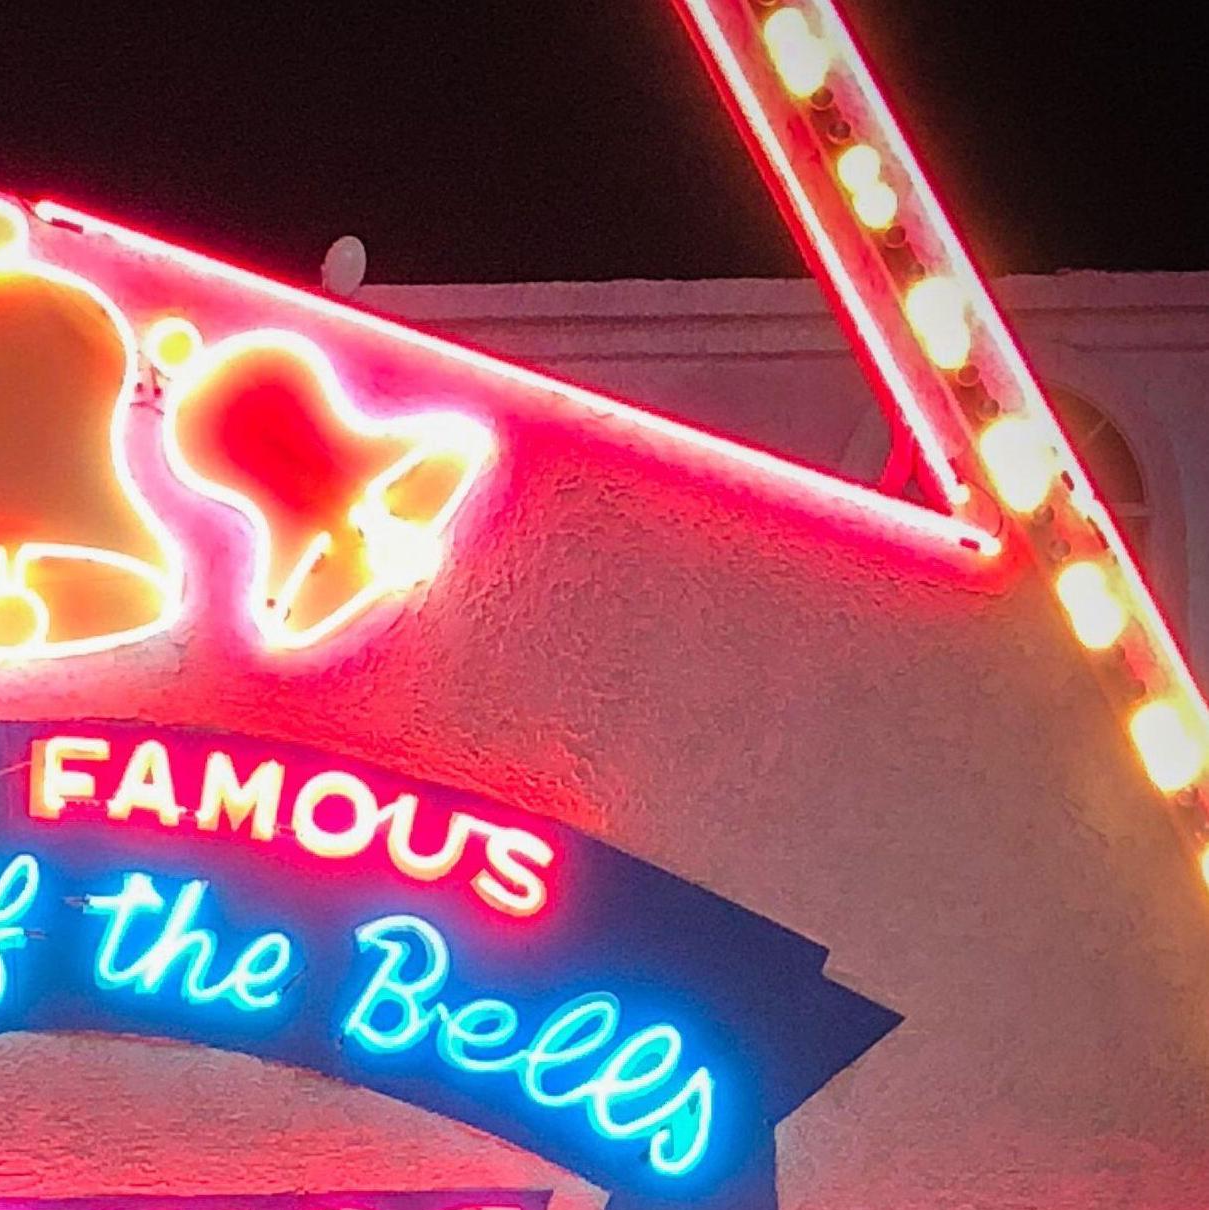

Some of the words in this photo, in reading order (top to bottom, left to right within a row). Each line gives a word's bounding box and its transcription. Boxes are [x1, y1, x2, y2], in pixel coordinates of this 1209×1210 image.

[29, 735, 555, 917] FAMOUS
[81, 870, 293, 1009] the
[342, 914, 716, 1176] Bells
